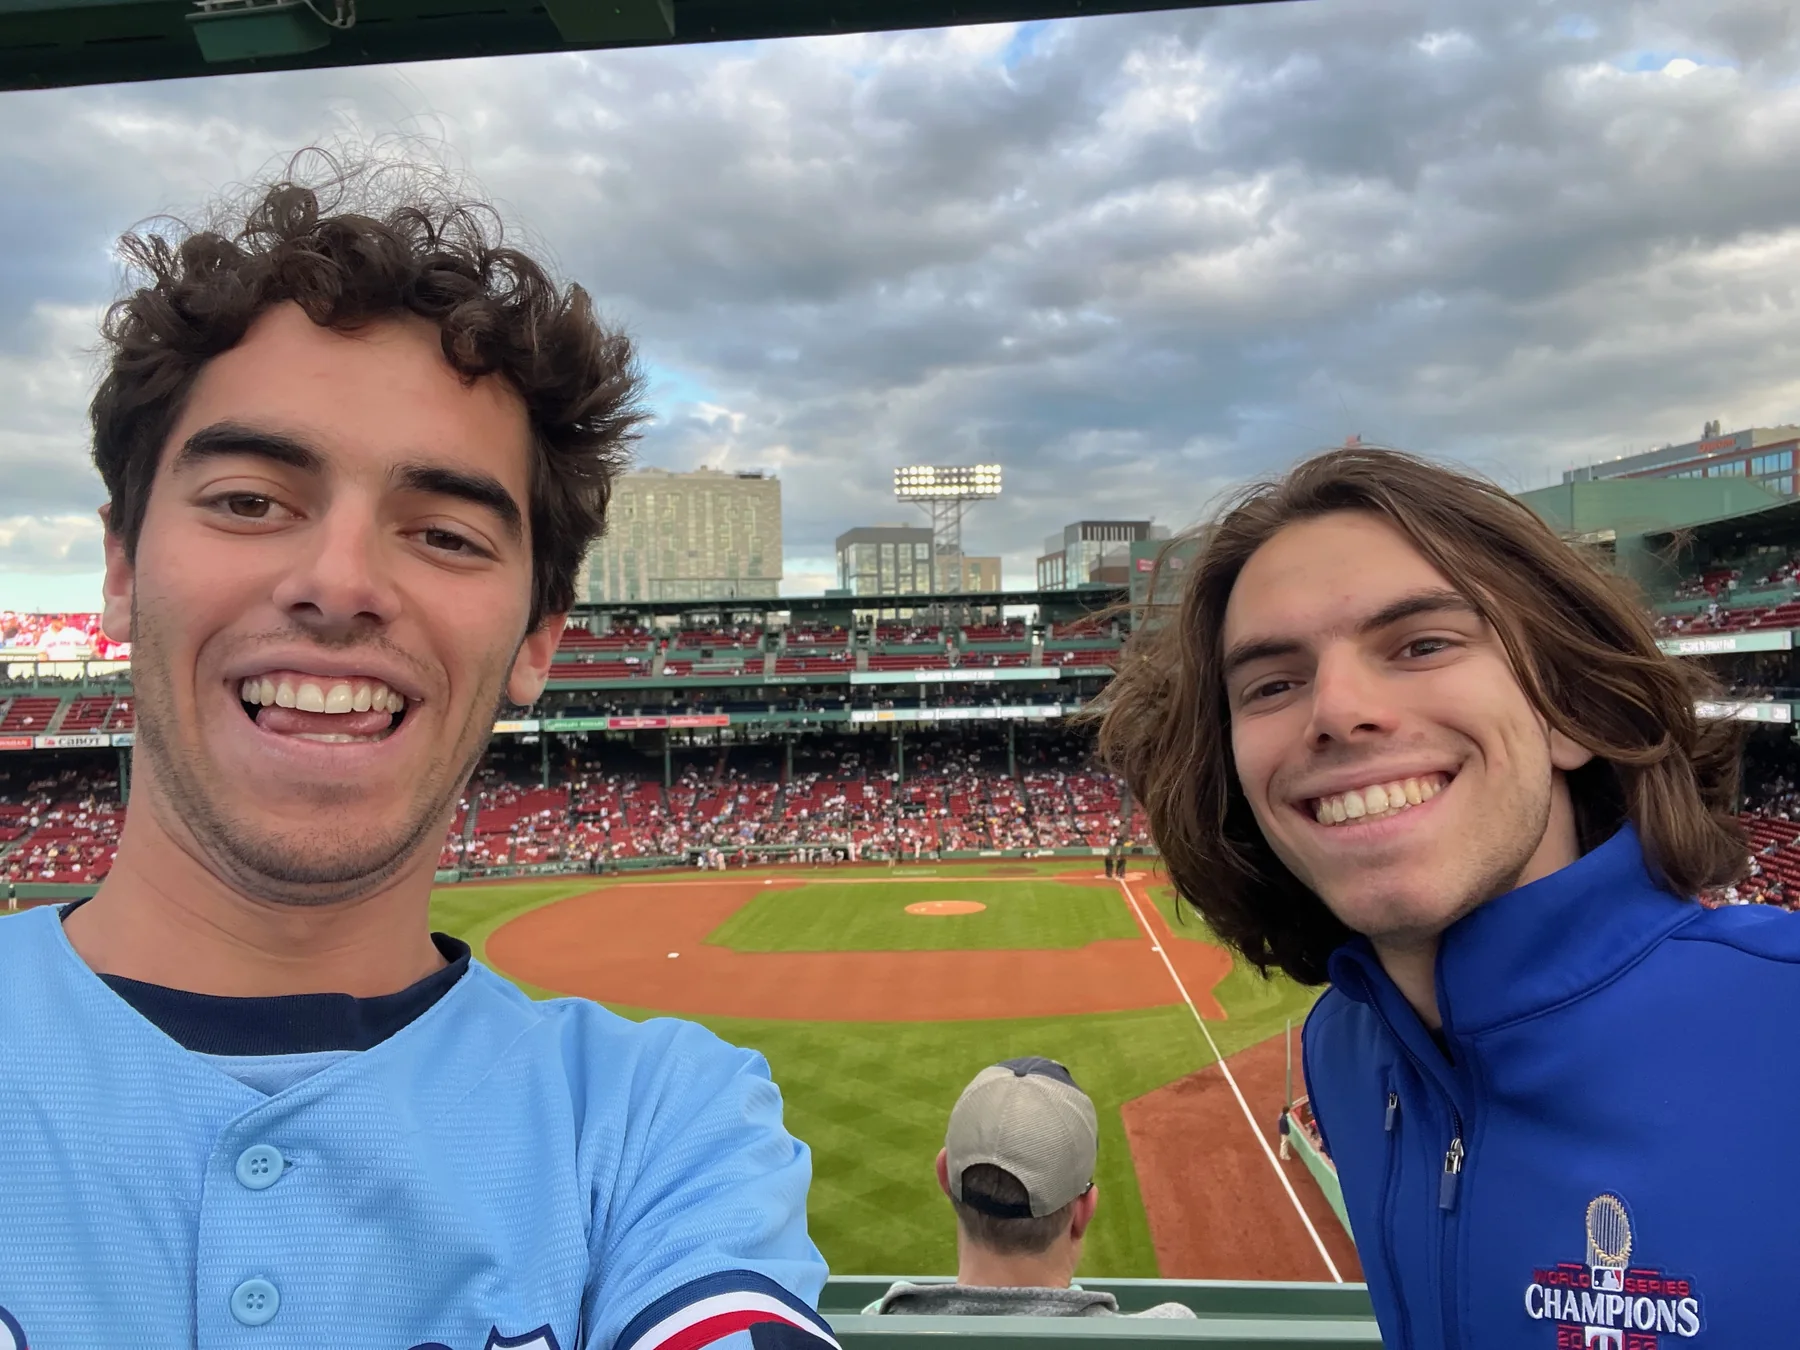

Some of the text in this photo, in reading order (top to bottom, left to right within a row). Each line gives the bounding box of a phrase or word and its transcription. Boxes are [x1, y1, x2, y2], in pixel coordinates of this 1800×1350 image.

[1533, 1269, 1689, 1296] WORLD SERIES
[1525, 1284, 1700, 1337] CHAMPIONS
